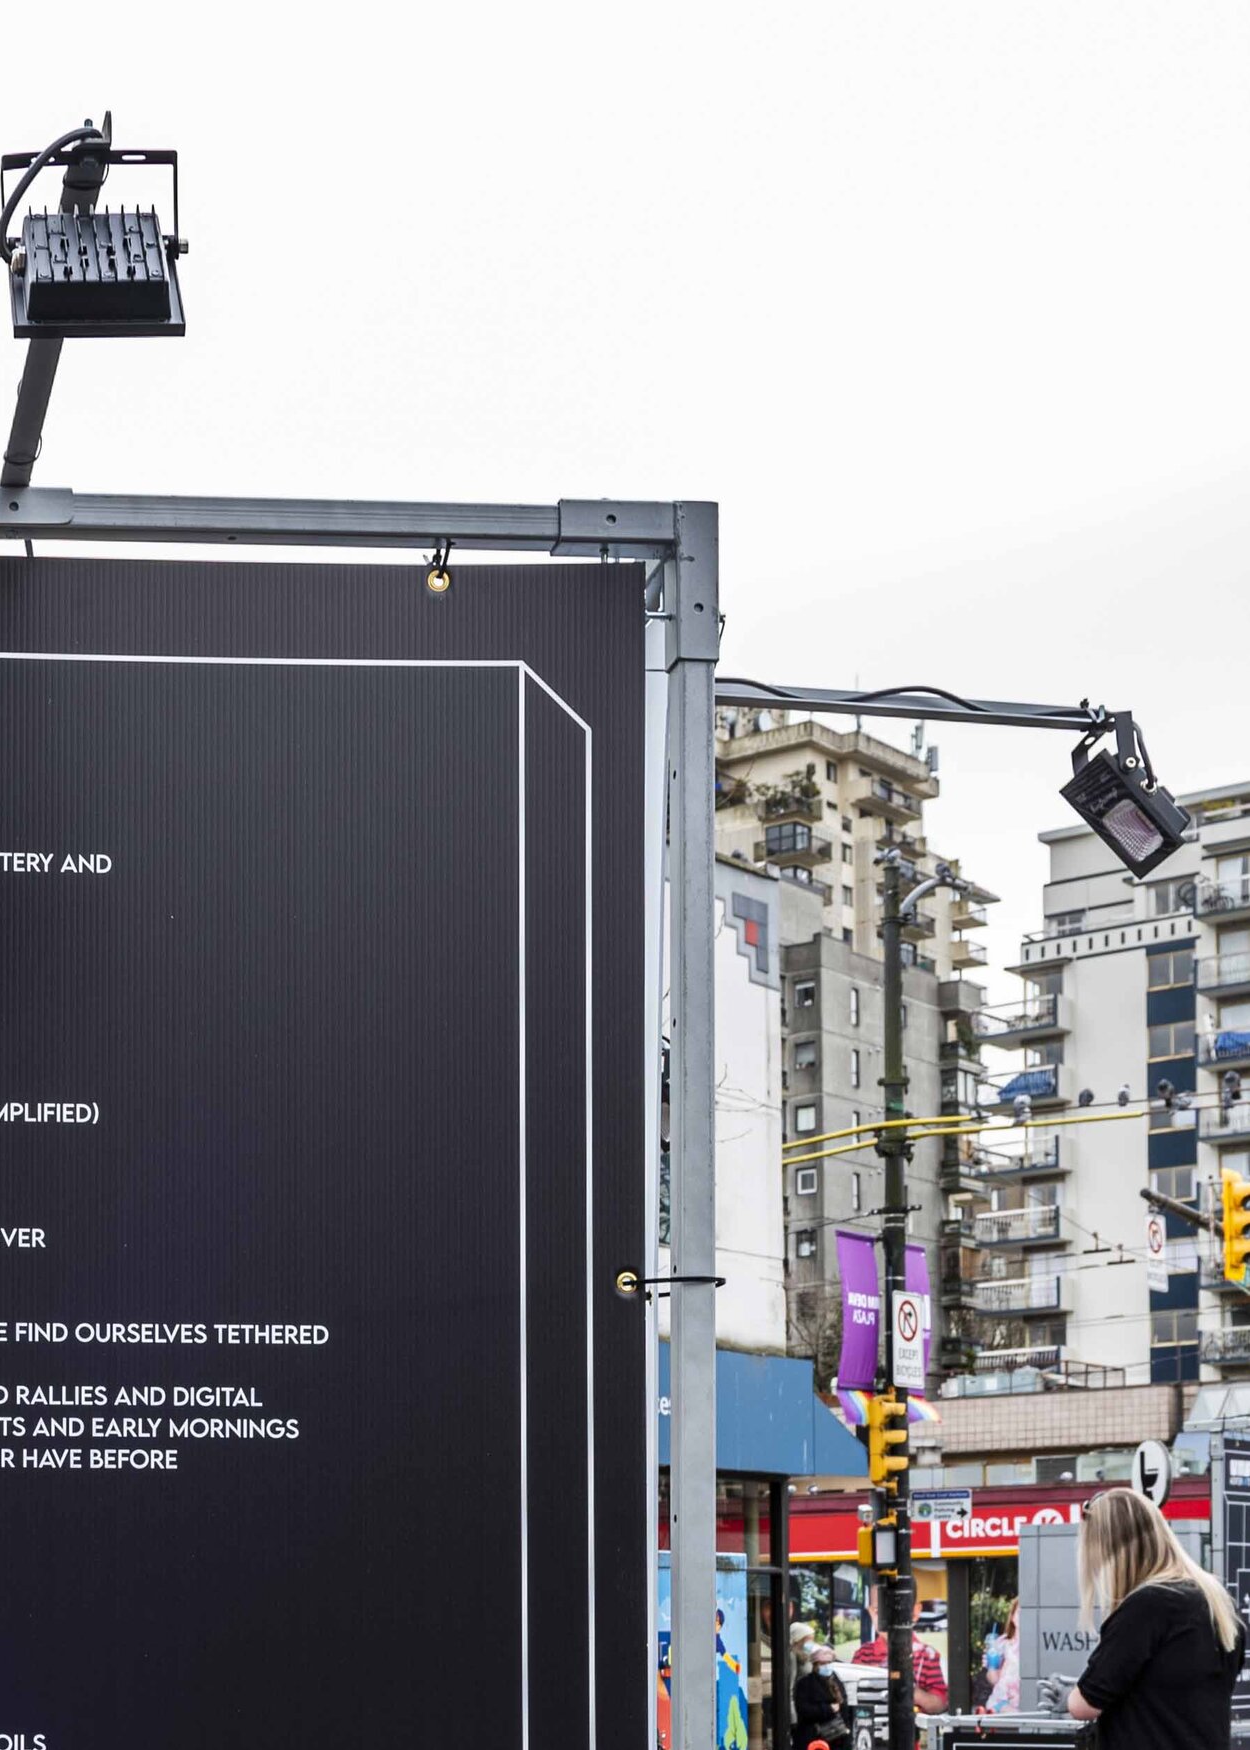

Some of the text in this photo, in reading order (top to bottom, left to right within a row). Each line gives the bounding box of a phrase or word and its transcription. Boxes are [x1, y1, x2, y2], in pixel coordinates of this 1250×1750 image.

[16, 1322, 68, 1342] FIND
[75, 1323, 207, 1343] OURSELVES
[214, 1324, 329, 1344] TETHERED
[33, 1417, 84, 1437] AND
[92, 1418, 162, 1437] EARLY
[169, 1418, 299, 1438] MORNINGS
